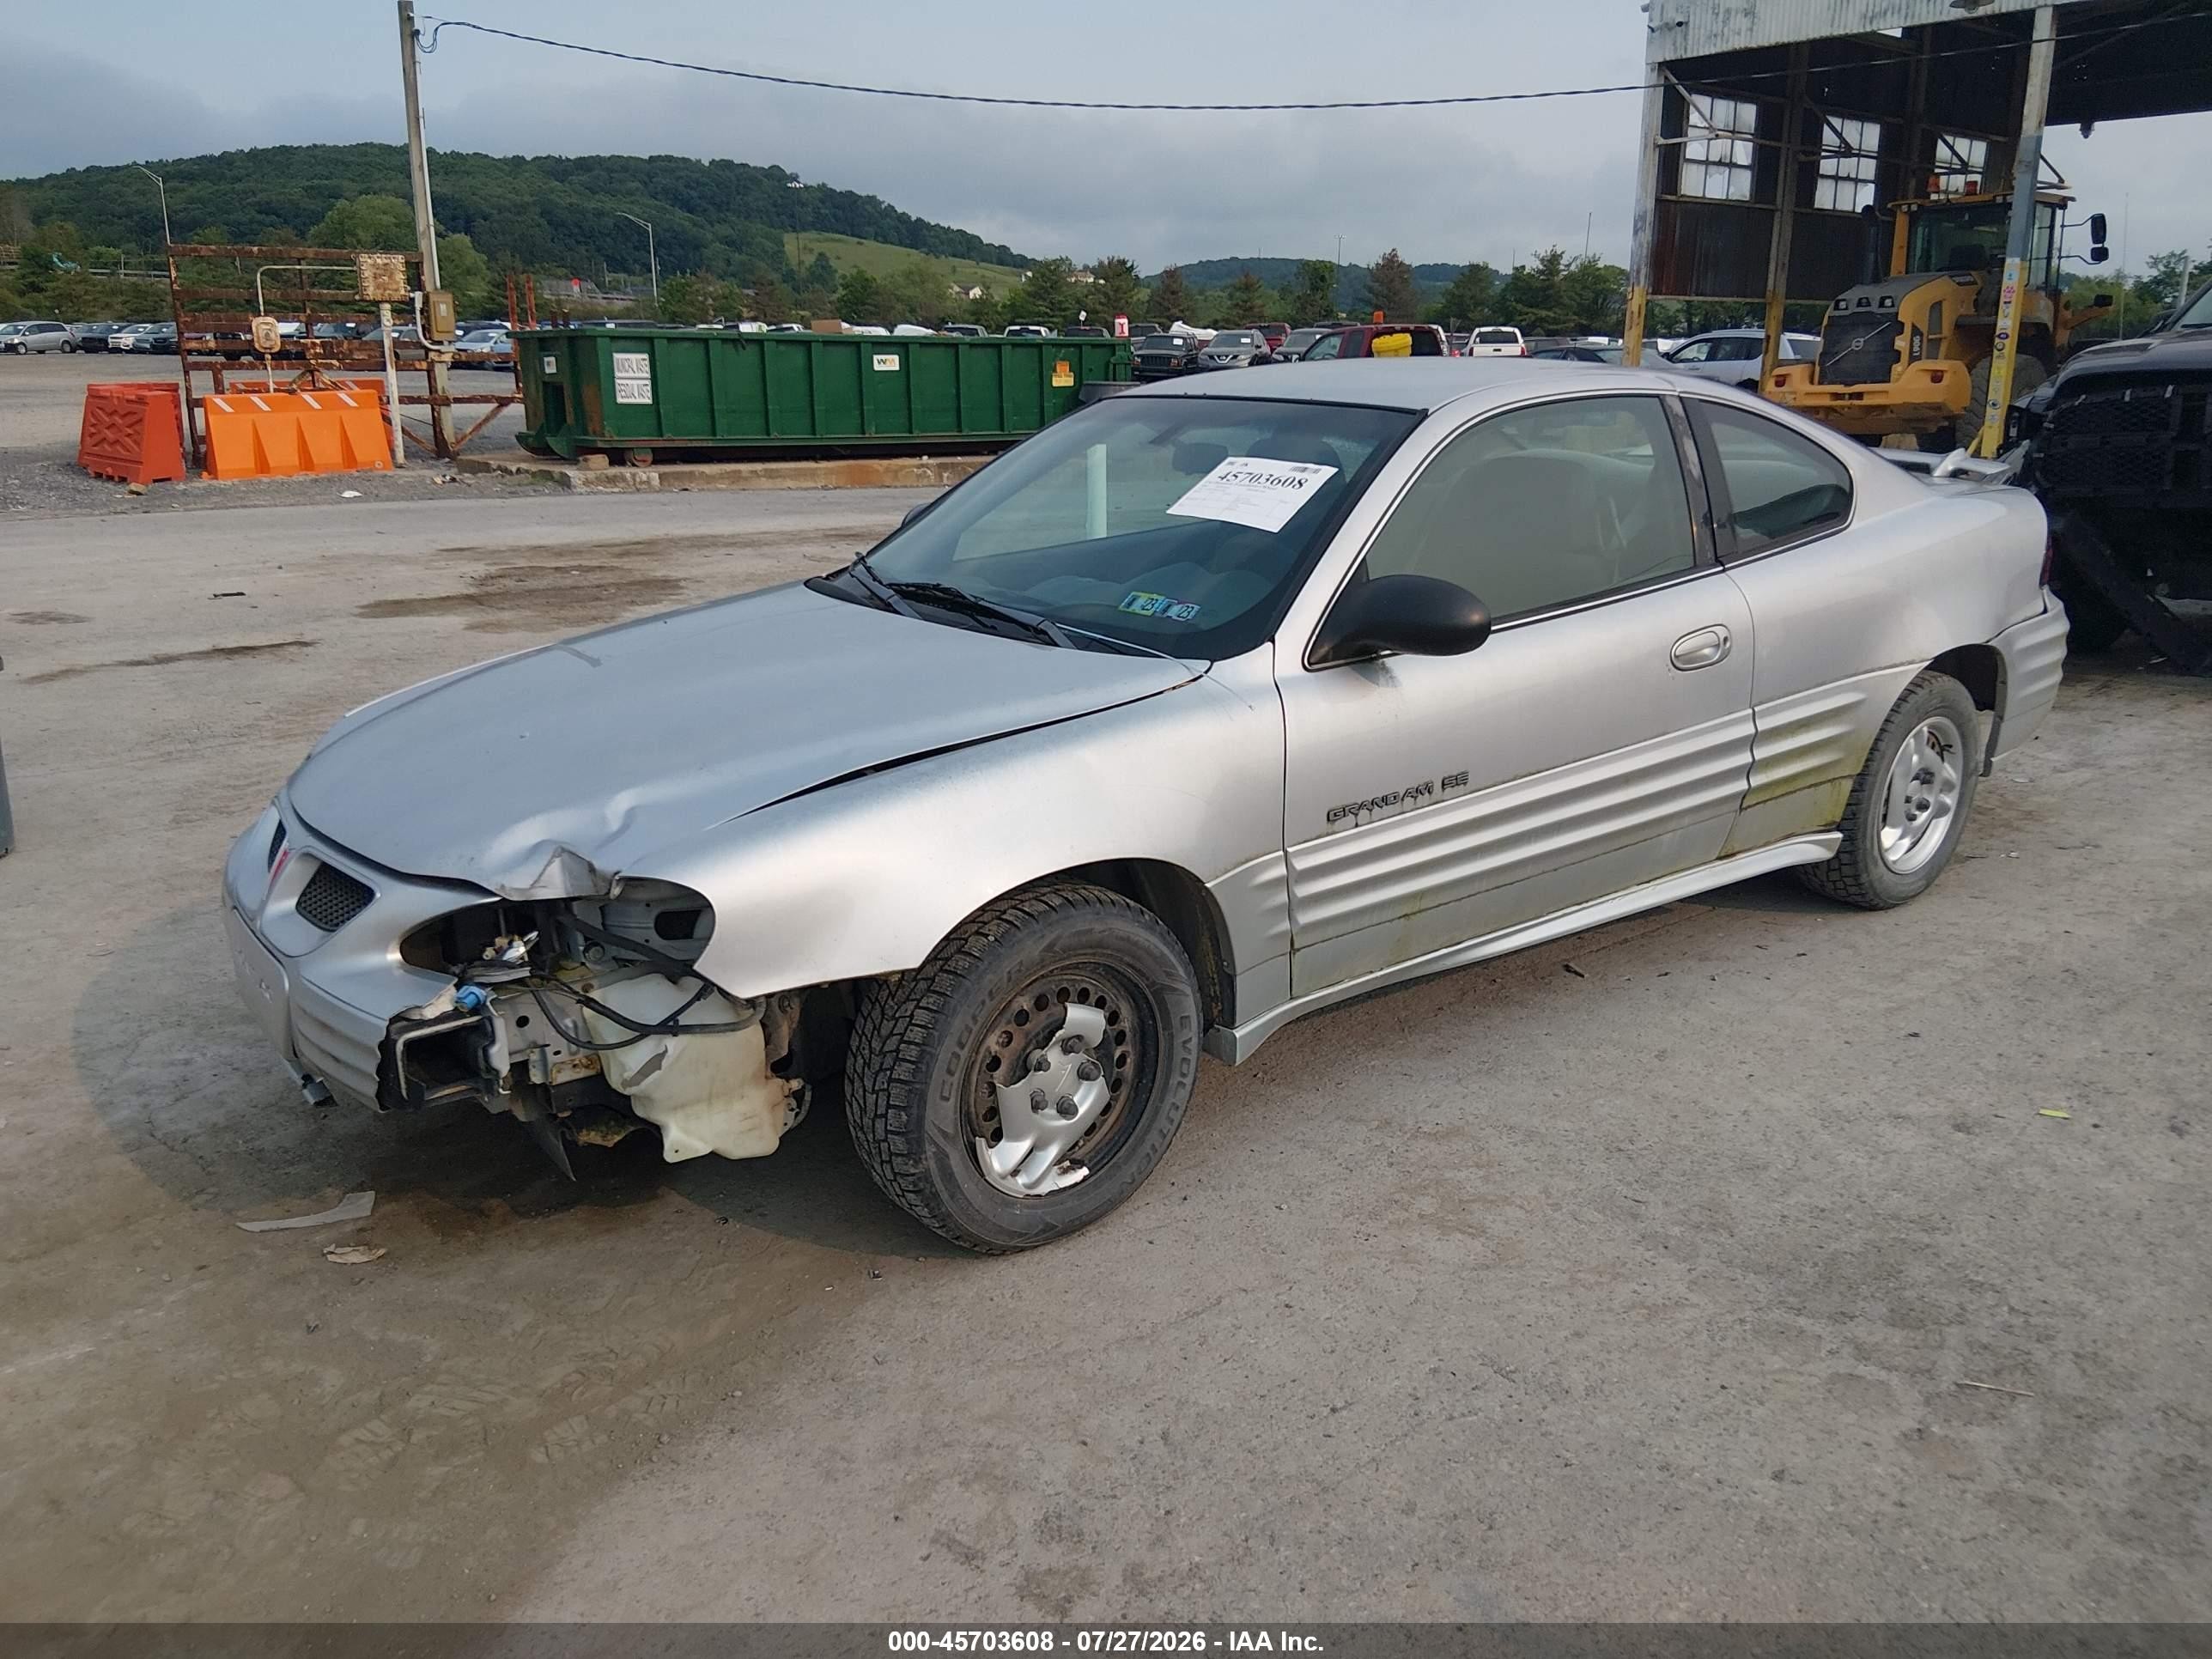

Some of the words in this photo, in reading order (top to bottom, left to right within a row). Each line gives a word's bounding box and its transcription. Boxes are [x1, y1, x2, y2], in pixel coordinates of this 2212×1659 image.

[1218, 471, 1309, 490] 45703608
[1177, 605, 1196, 619] 23
[1327, 791, 1400, 822] GRAND
[1401, 781, 1434, 802] AM
[1441, 770, 1470, 793] SE
[939, 957, 1025, 1103] COOPER
[1120, 1013, 1193, 1197] EVOLUTION
